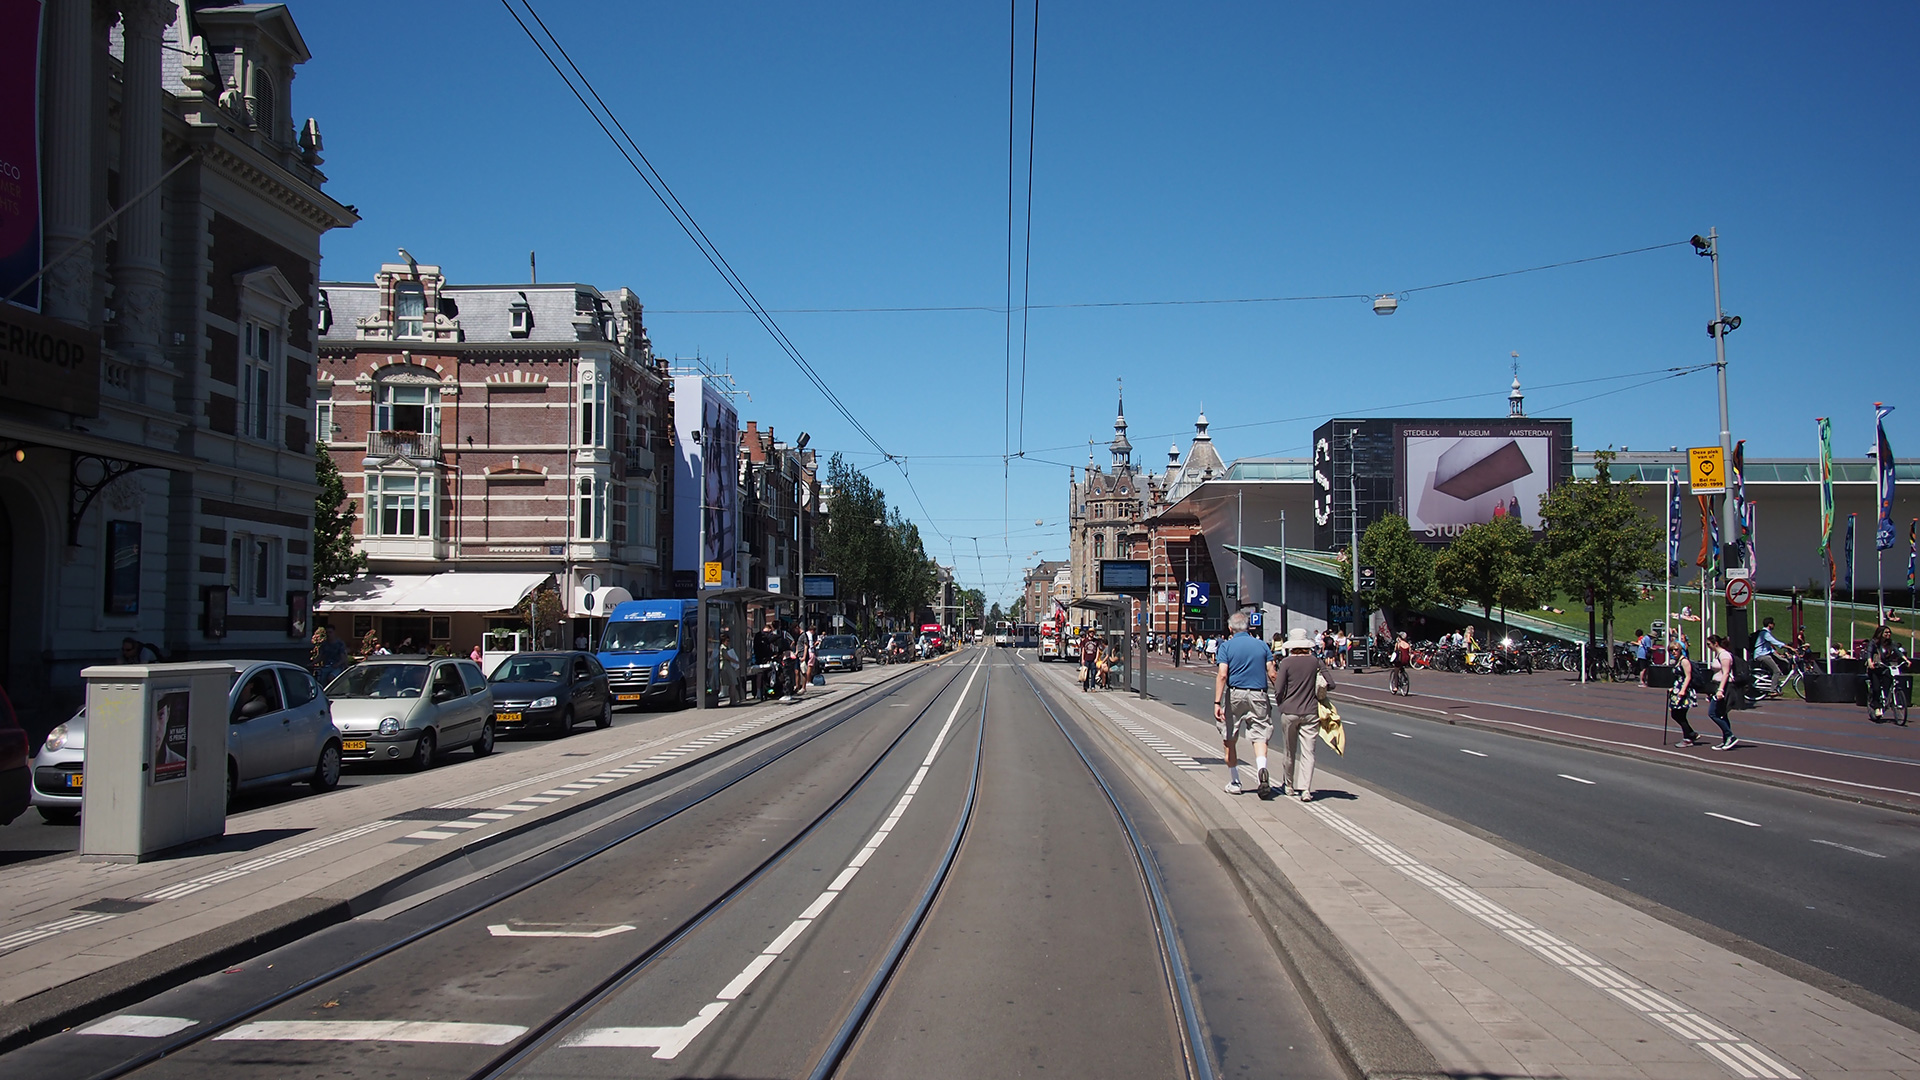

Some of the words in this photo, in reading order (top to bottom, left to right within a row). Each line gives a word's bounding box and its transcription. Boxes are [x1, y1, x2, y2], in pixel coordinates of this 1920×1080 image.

[1403, 429, 1440, 438] STEDELIJK
[1458, 429, 1491, 438] MUSEUM
[1508, 429, 1553, 438] AMSTERDAM
[1424, 523, 1482, 538] STUD
[1186, 586, 1199, 604] P
[1252, 614, 1259, 624] P
